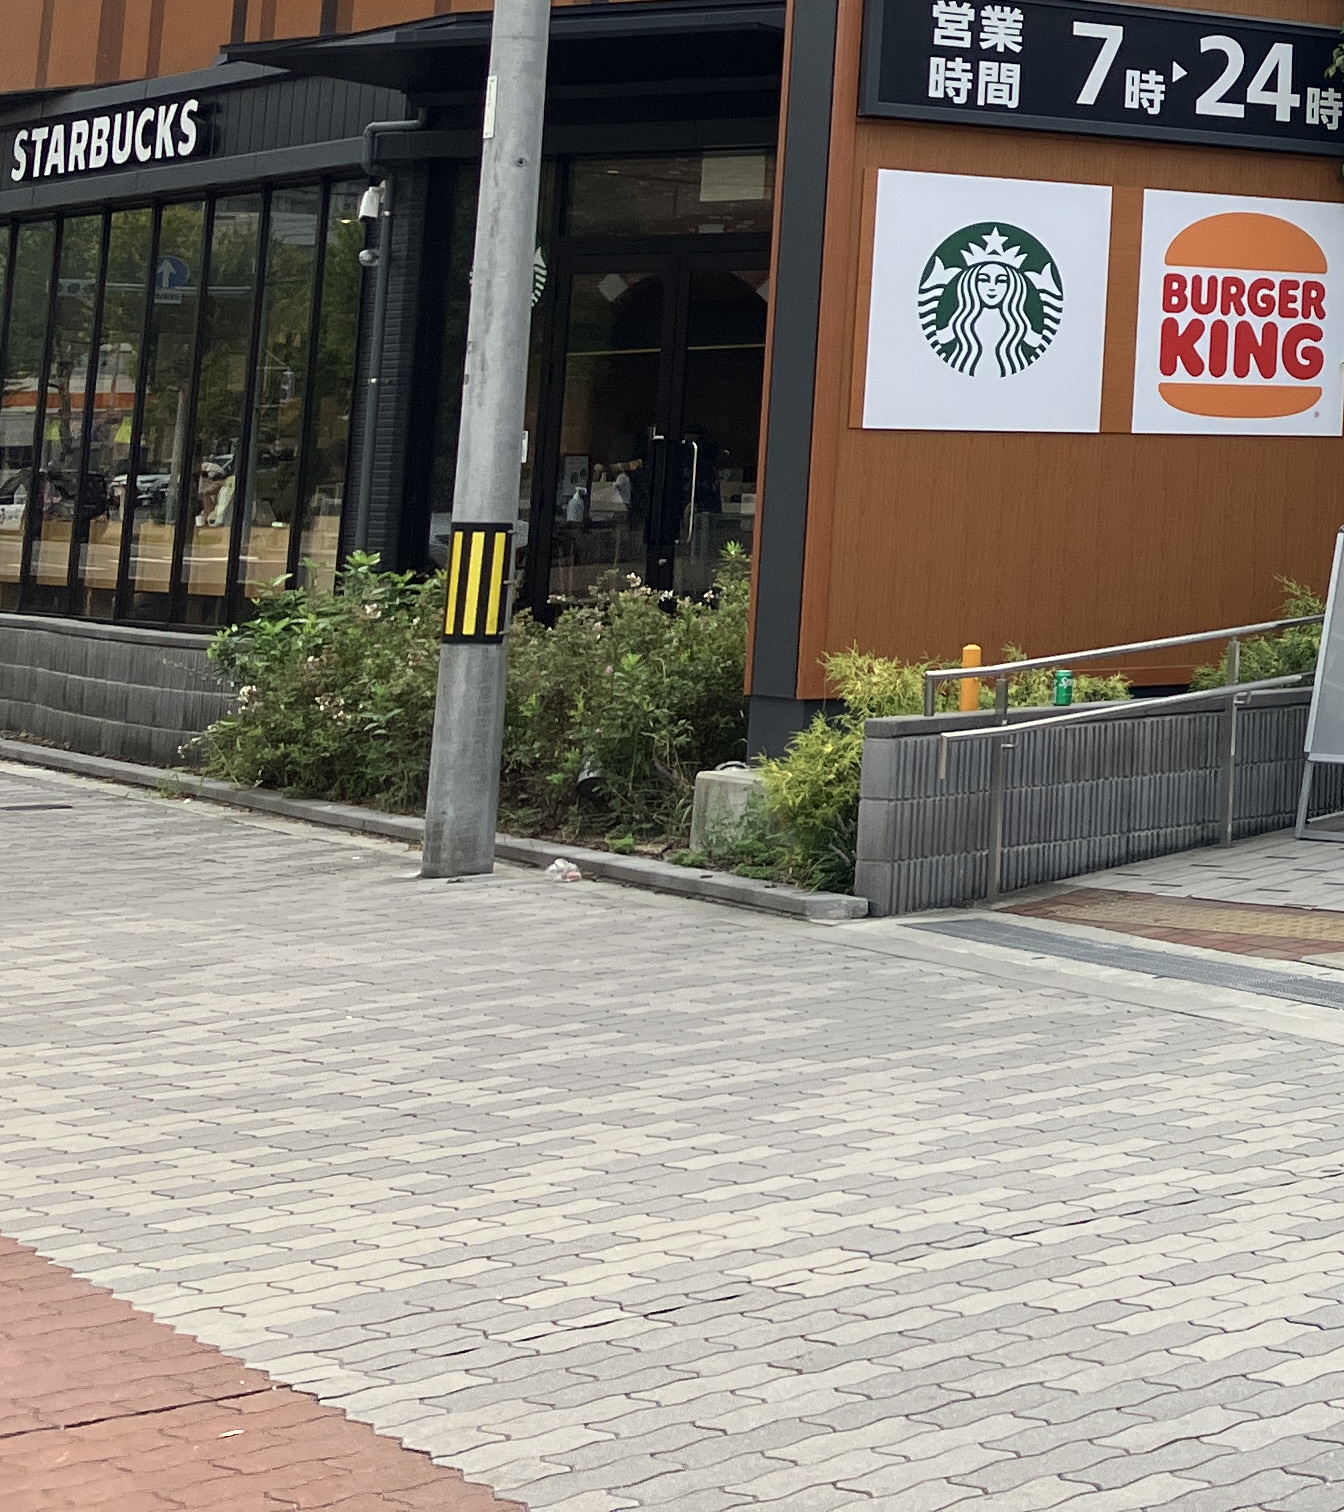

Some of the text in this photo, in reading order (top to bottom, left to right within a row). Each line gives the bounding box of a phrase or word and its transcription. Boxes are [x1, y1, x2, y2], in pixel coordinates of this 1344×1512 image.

[932, 0, 1024, 54] 営業
[928, 56, 1022, 109] 時間
[10, 98, 200, 183] STARBUCKS
[1162, 272, 1327, 321] BURGER
[1158, 317, 1325, 380] KING
